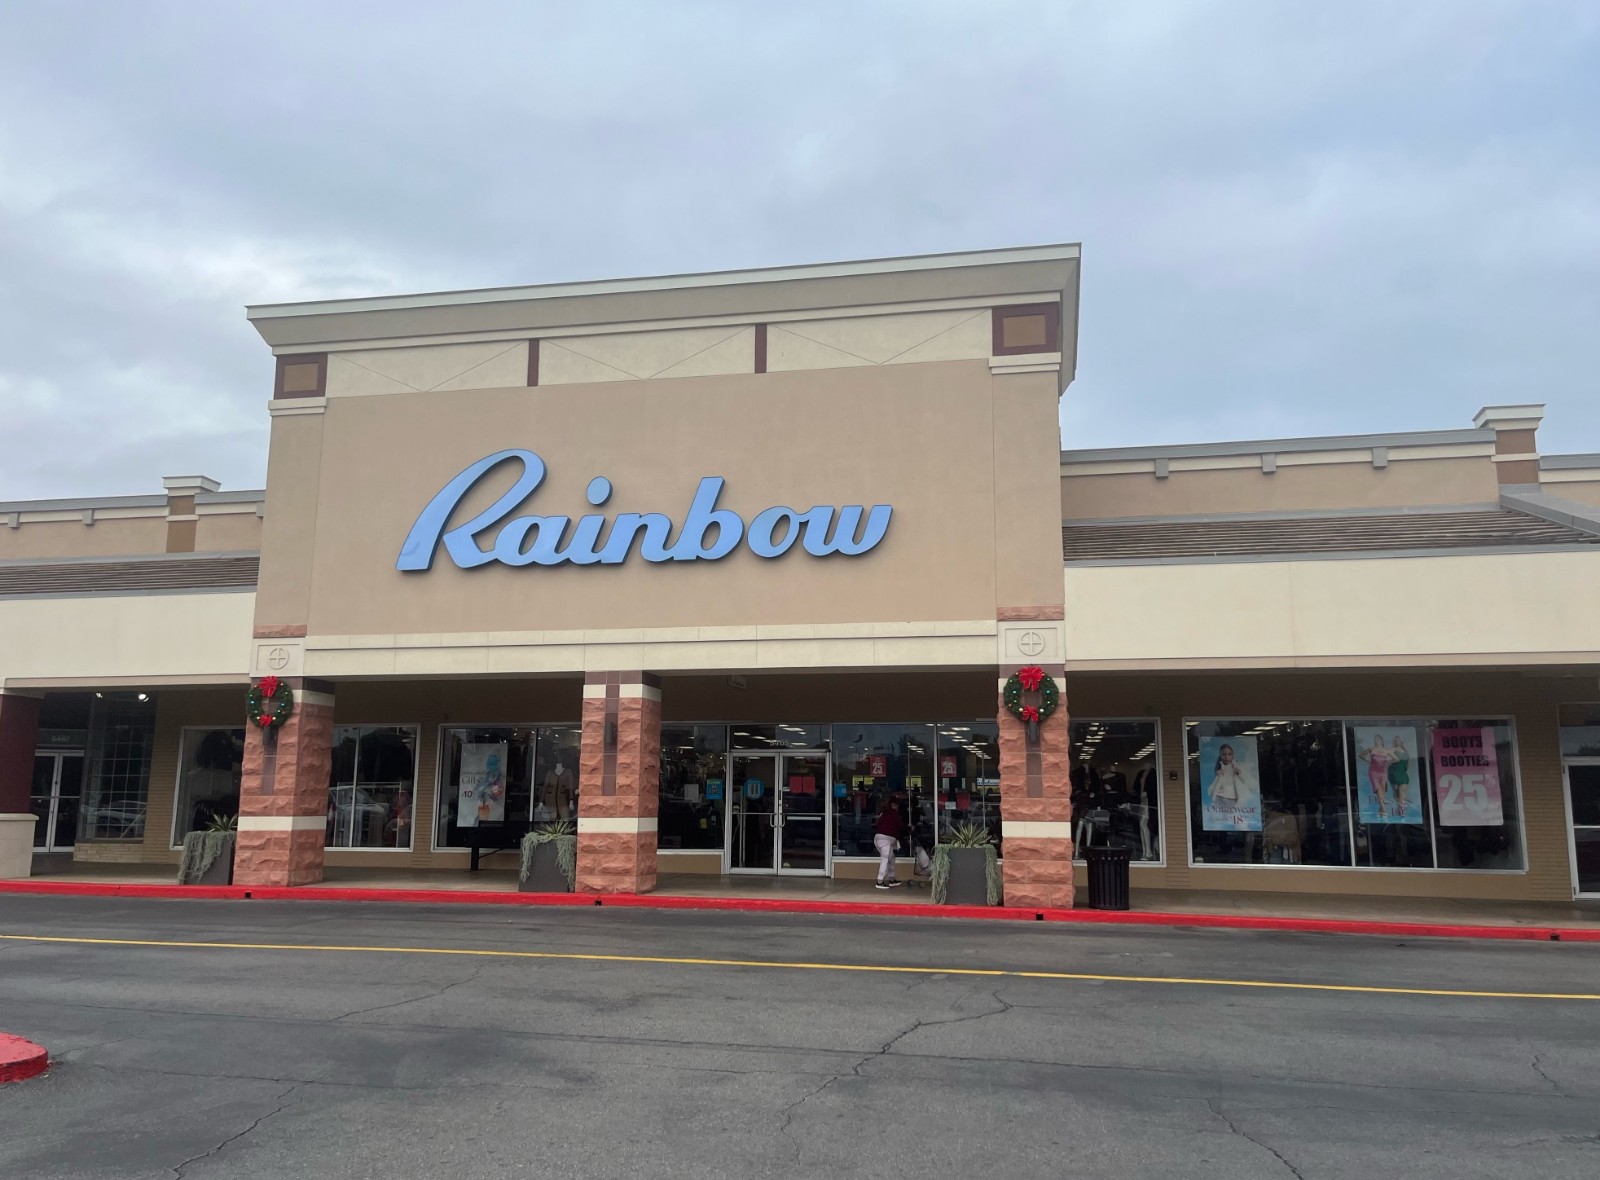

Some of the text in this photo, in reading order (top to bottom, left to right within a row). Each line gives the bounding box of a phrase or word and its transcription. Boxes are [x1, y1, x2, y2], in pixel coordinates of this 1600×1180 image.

[395, 448, 894, 573] Rainbow
[1442, 735, 1483, 748] BOOTS
[1440, 755, 1489, 768] BOOTIES
[1206, 804, 1257, 814] Outerwear
